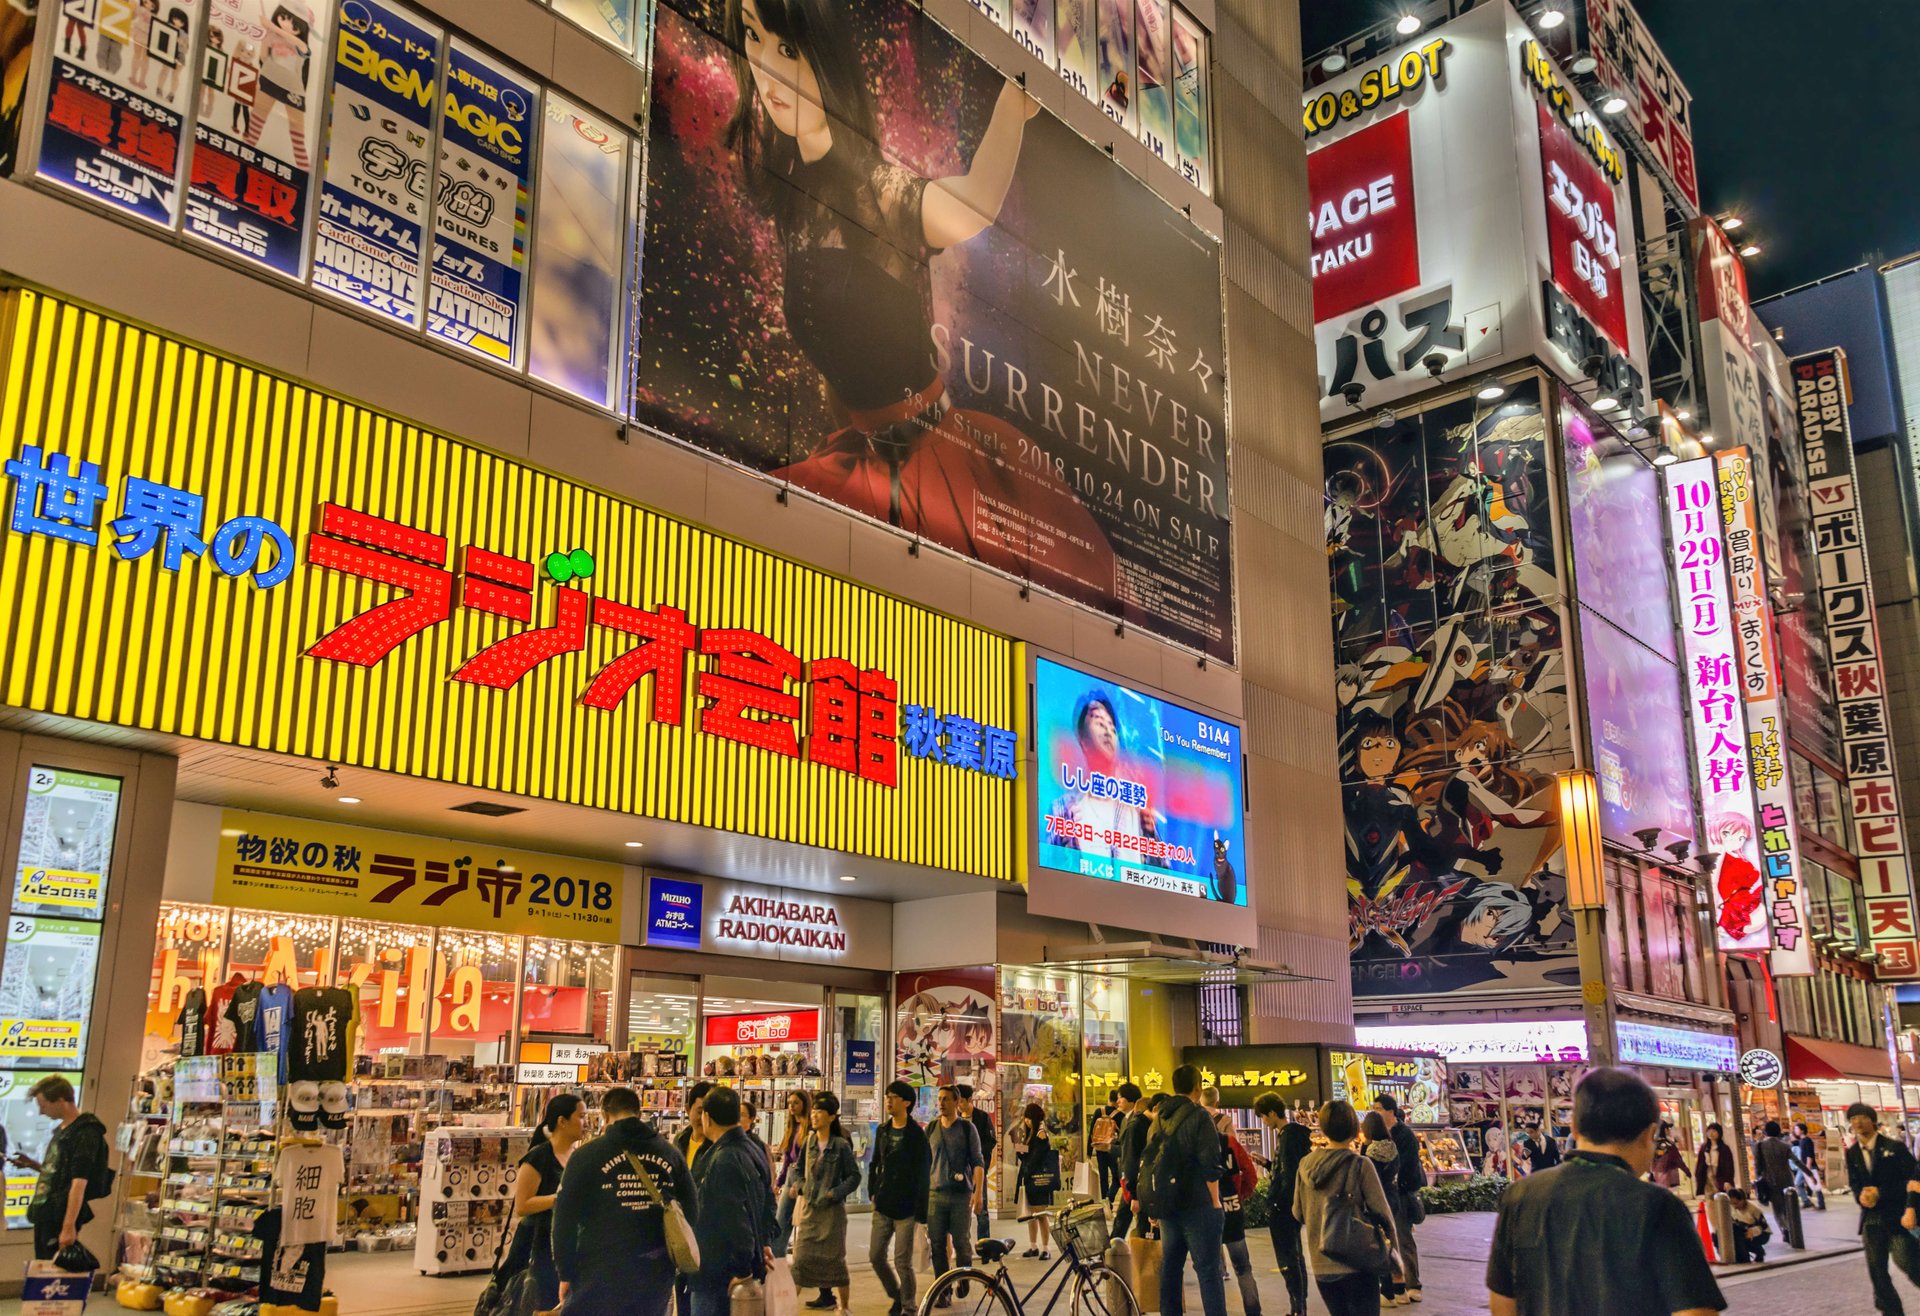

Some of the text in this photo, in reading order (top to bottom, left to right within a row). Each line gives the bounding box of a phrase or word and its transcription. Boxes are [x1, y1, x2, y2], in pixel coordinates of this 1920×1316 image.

[350, 174, 499, 254] TOYS & IGURES
[1550, 160, 1621, 269] エスパス
[1041, 248, 1213, 394] 水樹奈々
[1329, 298, 1465, 397] パス
[929, 322, 1219, 521] SURRENDER
[1073, 339, 1217, 464] NEVER
[1796, 363, 1827, 478] PARADISE
[1815, 358, 1844, 434] HOBBY
[904, 387, 943, 422] 38th
[952, 412, 1008, 455] Single
[1017, 438, 1125, 512] 2018.10.24
[1133, 497, 1160, 531] ON
[1169, 515, 1220, 561] SALE
[1732, 458, 1750, 503] DVD
[2, 444, 1021, 789] 世界の ラジオ会館 秋葉原
[1739, 618, 1768, 692] まっくす
[1176, 733, 1190, 748] You
[1197, 721, 1232, 747] B1A4
[1694, 652, 1747, 795] 新台入替
[1761, 716, 1785, 788] フィギュア
[36, 772, 53, 786] 2F
[1061, 763, 1148, 810] しし座の運勢
[236, 833, 362, 874] 物欲の秋
[1079, 858, 1114, 879] 詳しくは
[1760, 803, 1801, 951] とれじゃらす
[368, 852, 613, 919] ラジ市 2018
[660, 892, 692, 905] MIZUHO
[728, 894, 838, 927] AKIHABARA
[15, 921, 32, 934] 2F
[655, 918, 695, 930] ATMコーナー
[717, 918, 847, 952] RADIOKAIKAN
[1399, 1004, 1424, 1012] ESPACE
[292, 1164, 323, 1221] 細胞
[601, 1153, 627, 1174] MINT
